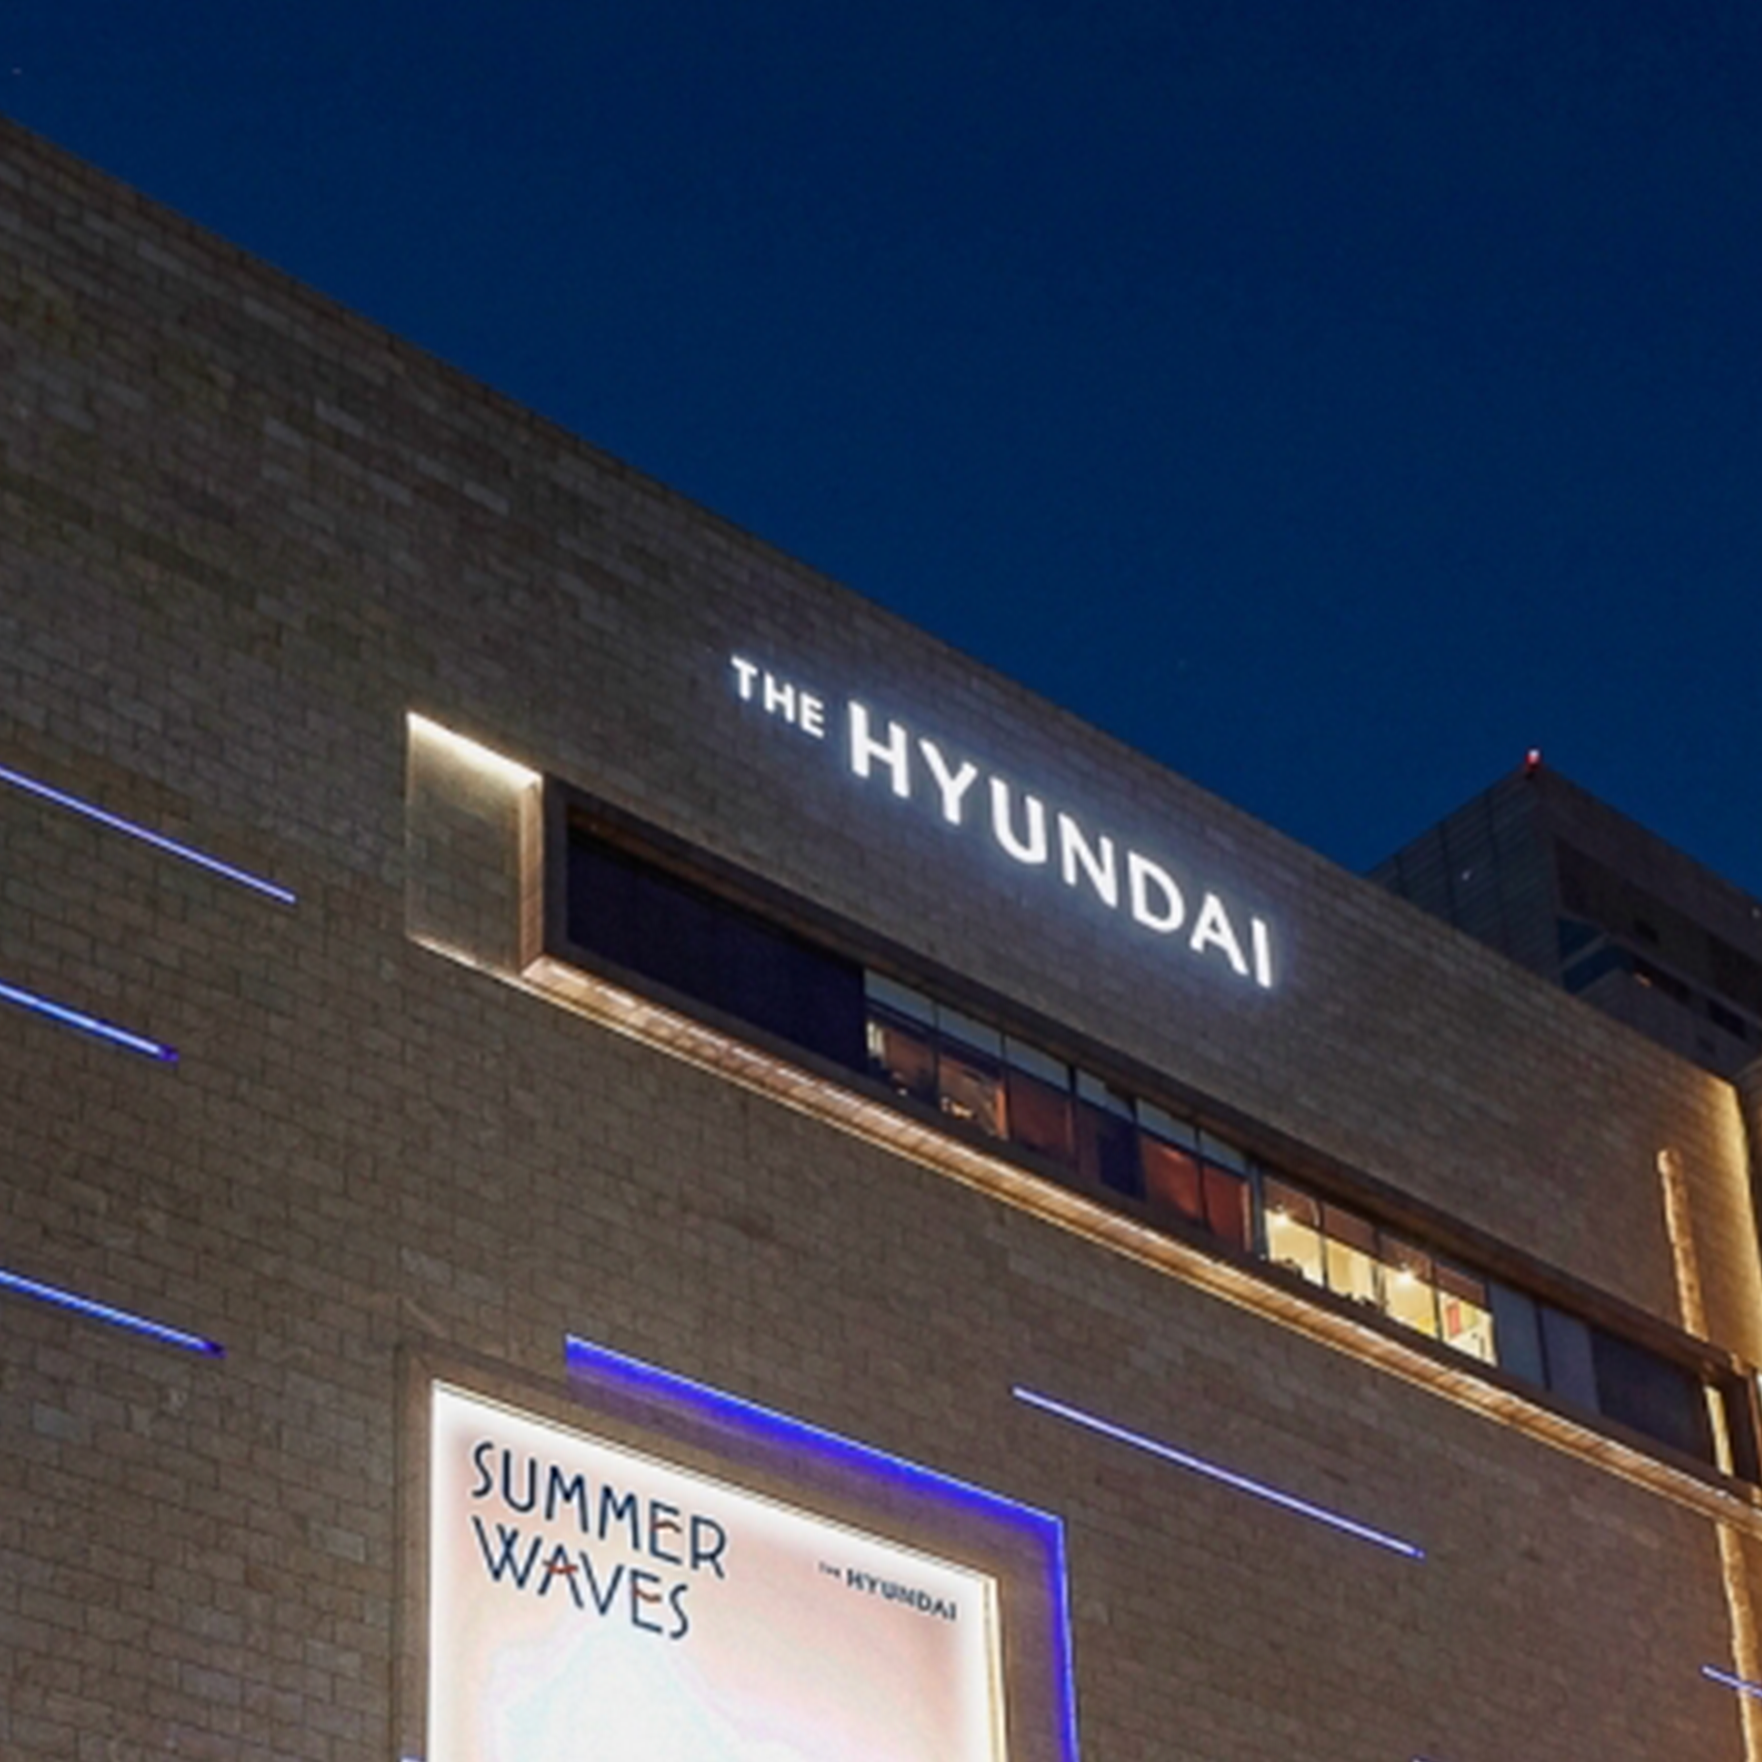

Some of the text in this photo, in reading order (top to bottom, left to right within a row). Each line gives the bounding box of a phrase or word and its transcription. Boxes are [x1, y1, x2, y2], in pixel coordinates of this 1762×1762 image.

[730, 654, 1273, 990] THE HYUNDAI
[470, 1441, 728, 1579] SUMMER
[471, 1515, 691, 1641] WAVES
[845, 1567, 958, 1621] HYUNDAI
